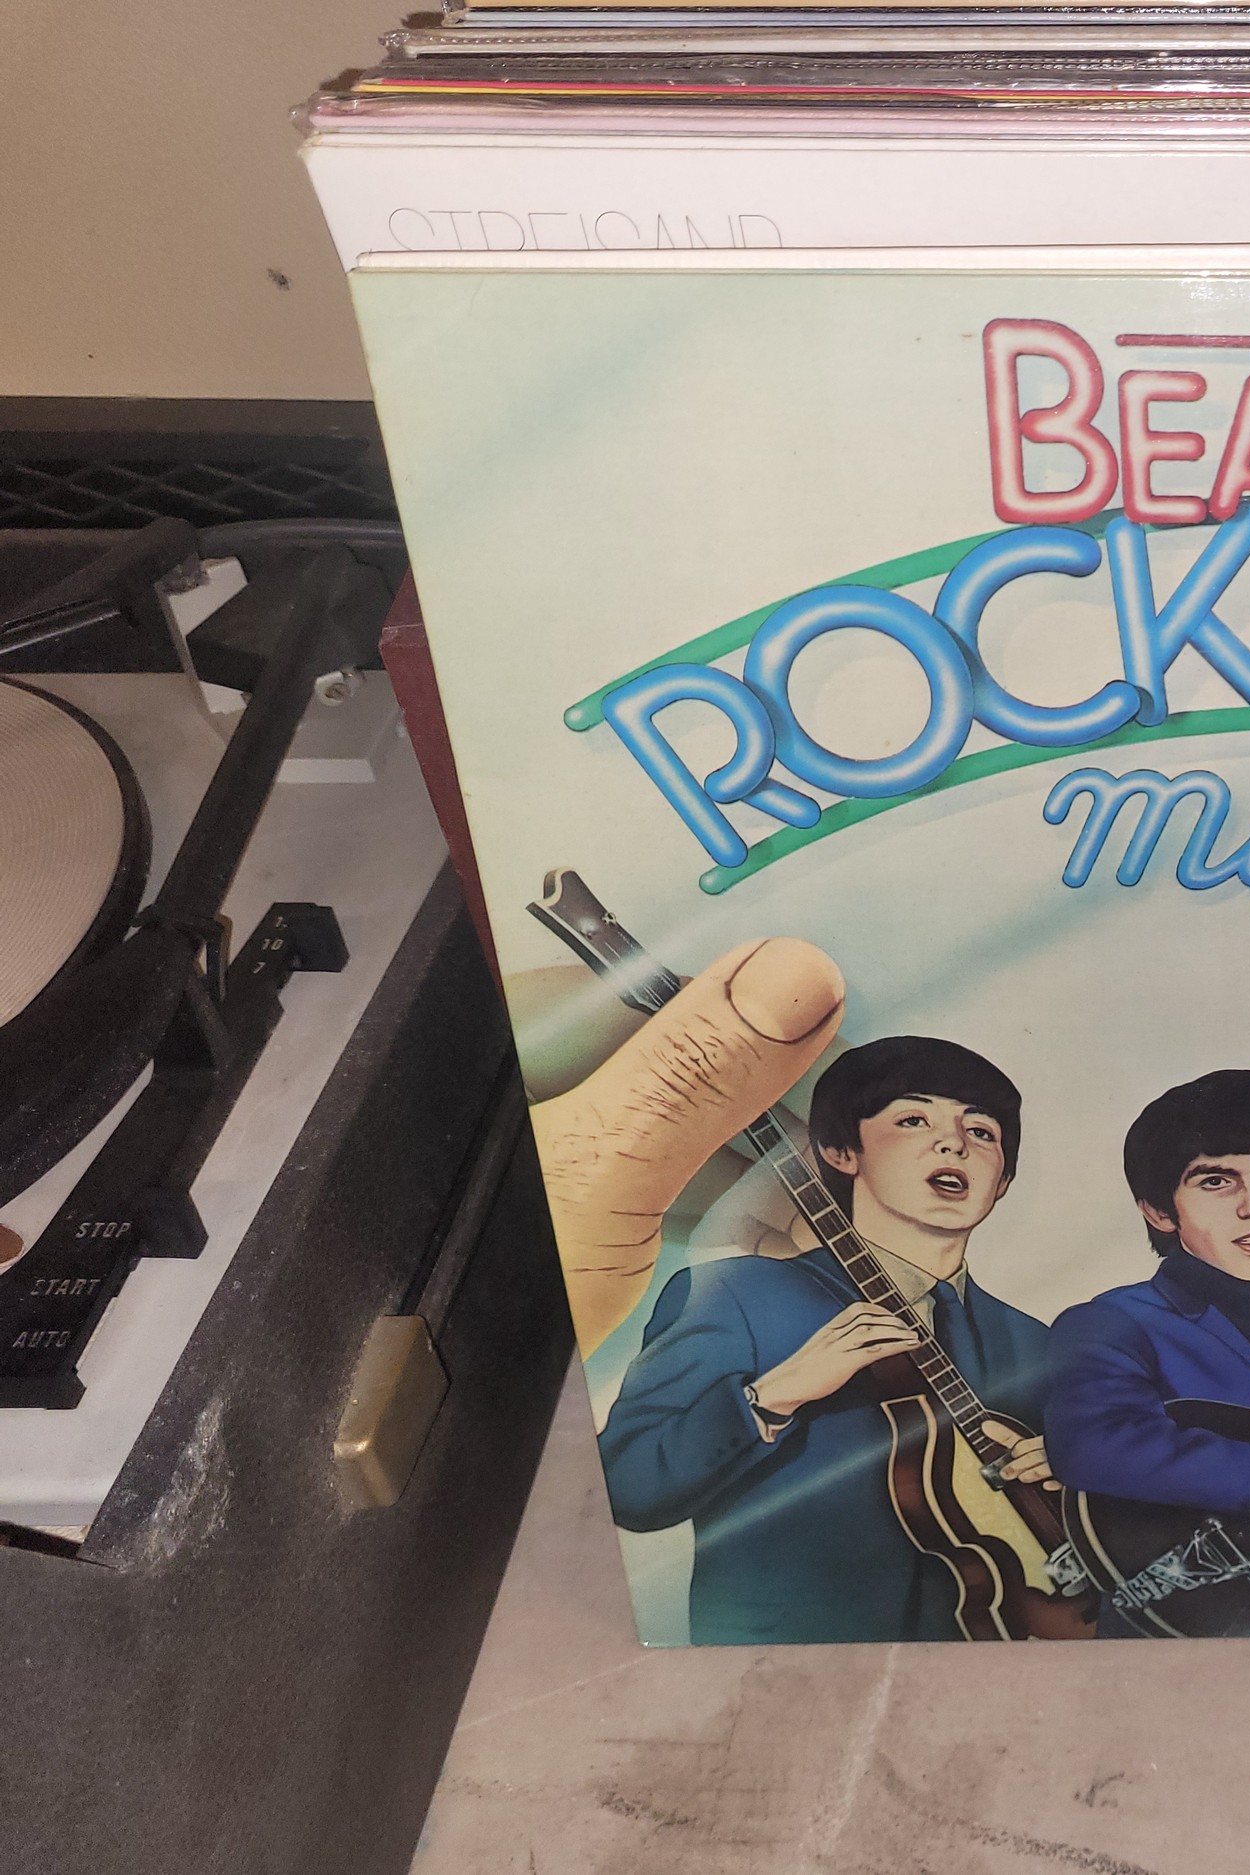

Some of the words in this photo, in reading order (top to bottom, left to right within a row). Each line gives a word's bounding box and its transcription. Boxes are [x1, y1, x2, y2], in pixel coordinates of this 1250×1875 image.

[75, 1222, 131, 1239] STOP
[30, 1278, 101, 1296] START
[12, 1330, 71, 1348] AUTO
